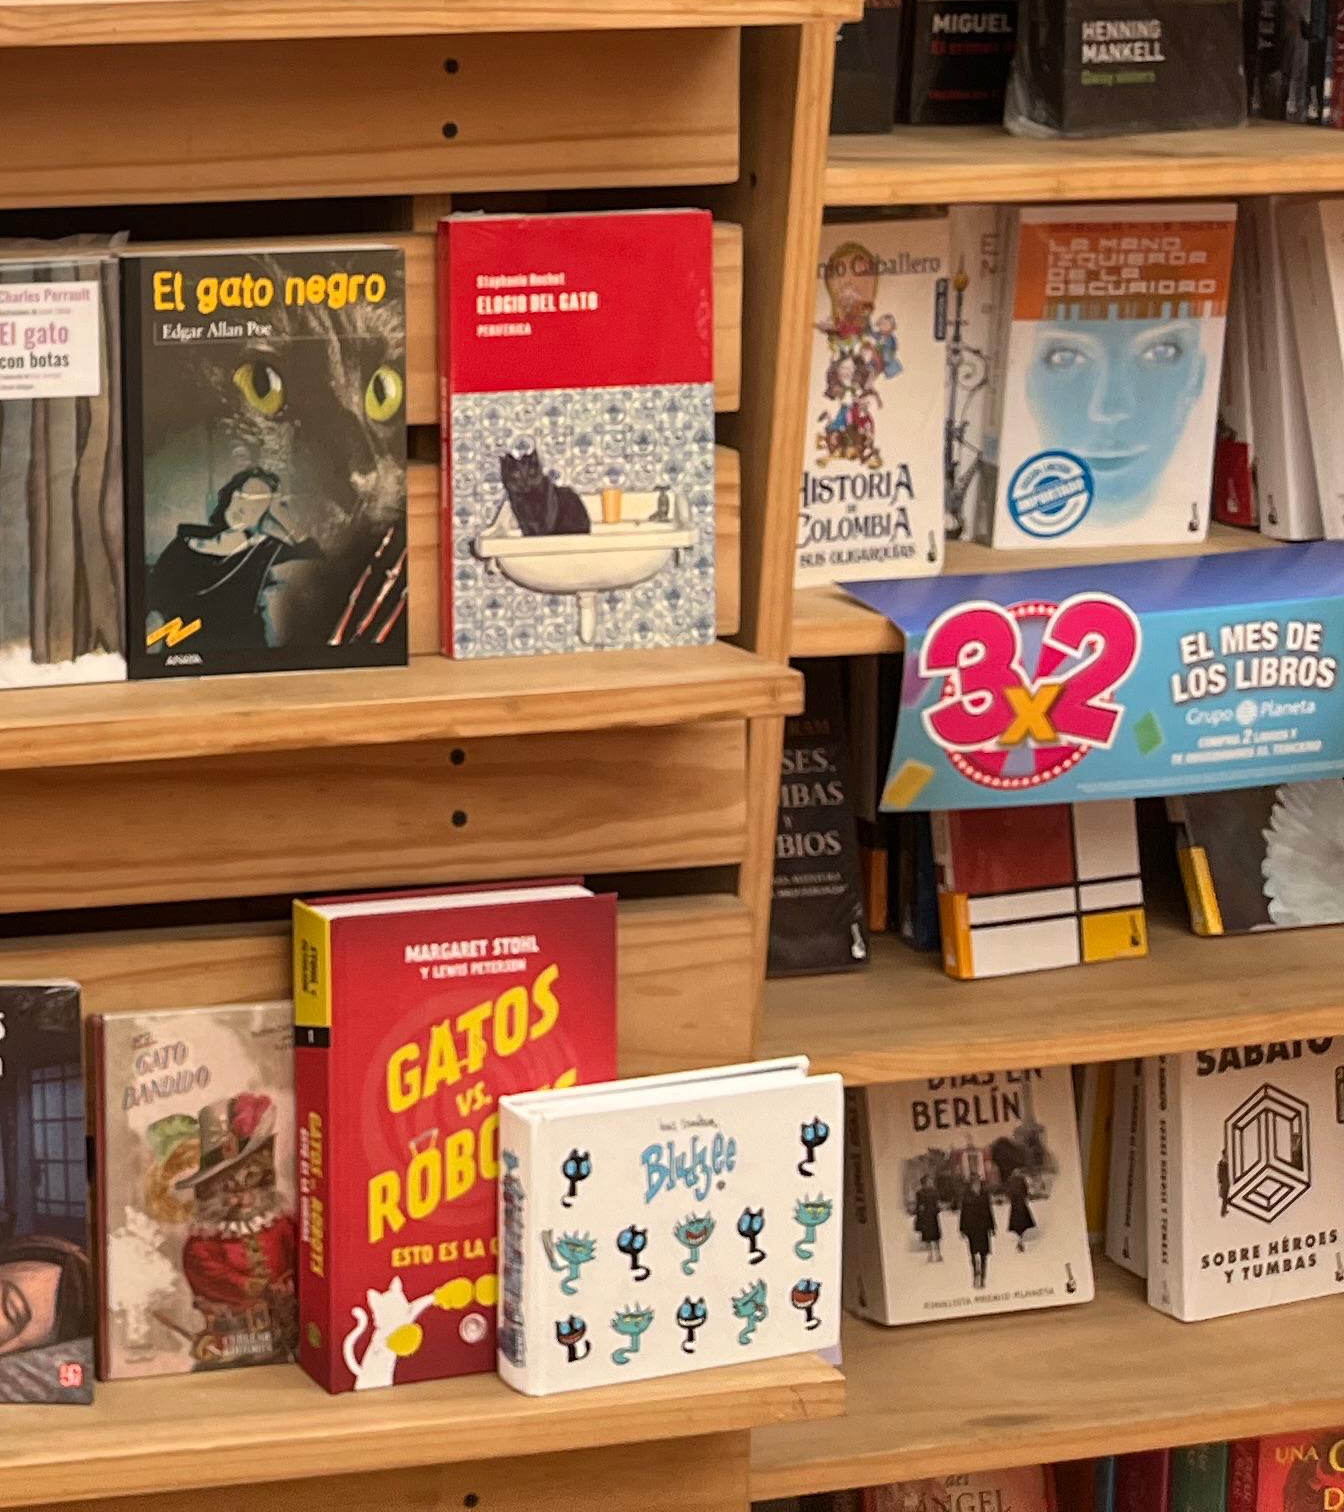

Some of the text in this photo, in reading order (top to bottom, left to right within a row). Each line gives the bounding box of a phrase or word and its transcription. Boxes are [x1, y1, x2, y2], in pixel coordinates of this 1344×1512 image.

[932, 13, 1011, 33] MIGUEL
[1082, 19, 1161, 40] HENNING
[1082, 41, 1166, 64] MANKELL
[851, 252, 941, 276] Caballero
[43, 287, 91, 303] Perrault
[152, 270, 387, 315] El gato negro
[476, 291, 598, 315] ELOGIO DEL GATO
[0, 322, 69, 351] El gato
[162, 320, 273, 342] Edgar Allan Poe
[0, 352, 70, 370] con botas
[1180, 620, 1323, 664] EL MES DE
[1171, 656, 1337, 704] LOS LIBROS
[1185, 699, 1316, 728] Grupo Planeta
[404, 939, 489, 963] MARGARET
[419, 967, 430, 980] Y
[386, 964, 561, 1113] GATOS
[135, 1041, 188, 1076] GATO
[122, 1064, 209, 1111] BANDIDO
[913, 1088, 1023, 1133] BERLÍN
[392, 1241, 485, 1268] ESTO ES LA
[1201, 1229, 1338, 1270] SOBRE HÉROES
[1224, 1253, 1318, 1284] Y TUMBAS
[1276, 1446, 1319, 1464] UNA
